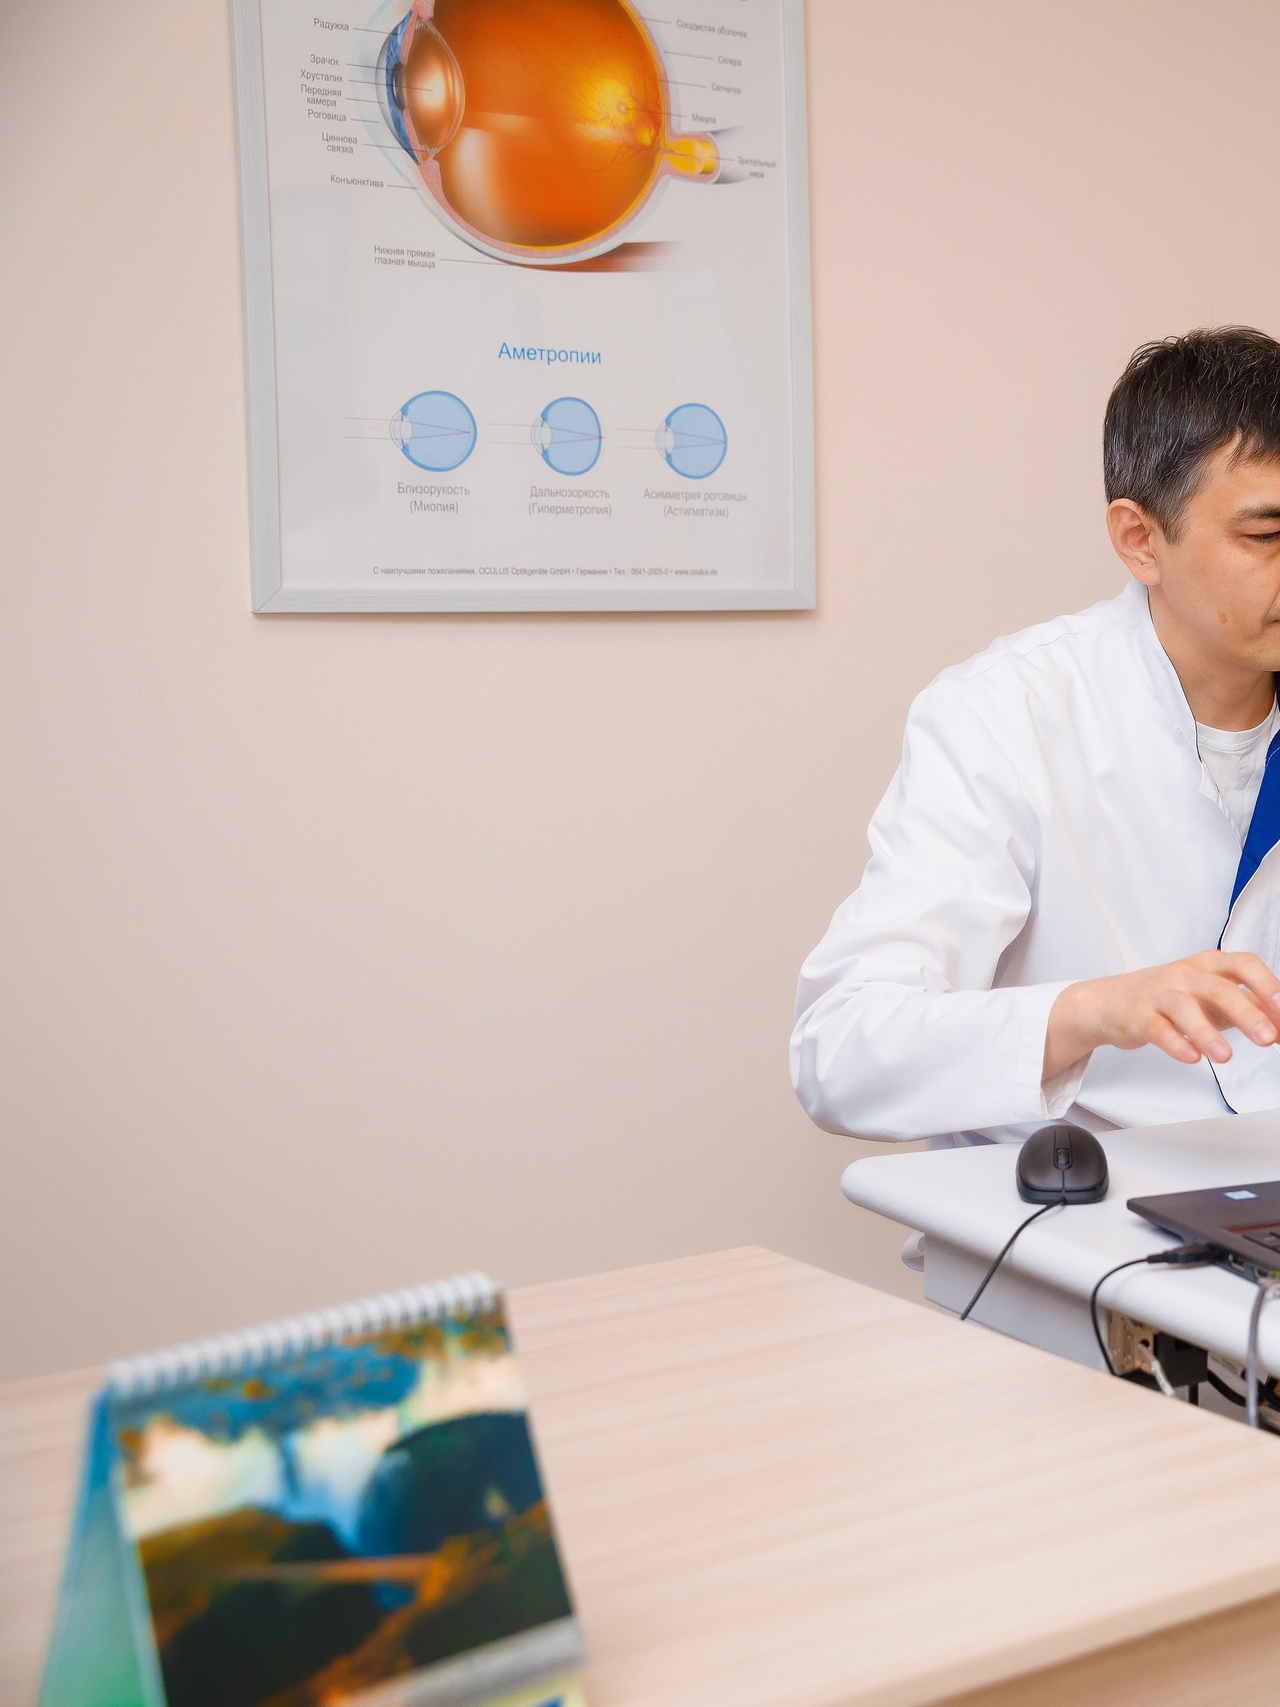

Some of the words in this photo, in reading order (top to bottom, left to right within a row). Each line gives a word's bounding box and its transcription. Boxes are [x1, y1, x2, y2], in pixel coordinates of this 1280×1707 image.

[313, 17, 349, 31] Радужка
[310, 54, 340, 66] Зрачок
[300, 69, 344, 83] Хрусталик
[300, 84, 342, 97] Передняя
[306, 97, 337, 108] камера
[307, 109, 347, 123] Роговица
[321, 132, 358, 144] Циннова
[326, 144, 354, 154] связка
[330, 174, 384, 188] Конъюнктива
[374, 245, 405, 256] Нижняя
[406, 249, 436, 259] прямая
[374, 257, 406, 266] глазная
[407, 260, 436, 270] мышца
[497, 342, 602, 366] Аметропии
[397, 482, 471, 497] Близорукость
[530, 485, 610, 500] Дальнозоркость
[643, 488, 702, 502] Асимметрия
[703, 492, 748, 503] роговицы
[409, 500, 459, 514] (Миопия)
[528, 502, 612, 517] (Гиперметропия)
[663, 505, 730, 519] (Астигматизм)
[479, 567, 510, 576] OCULUS
